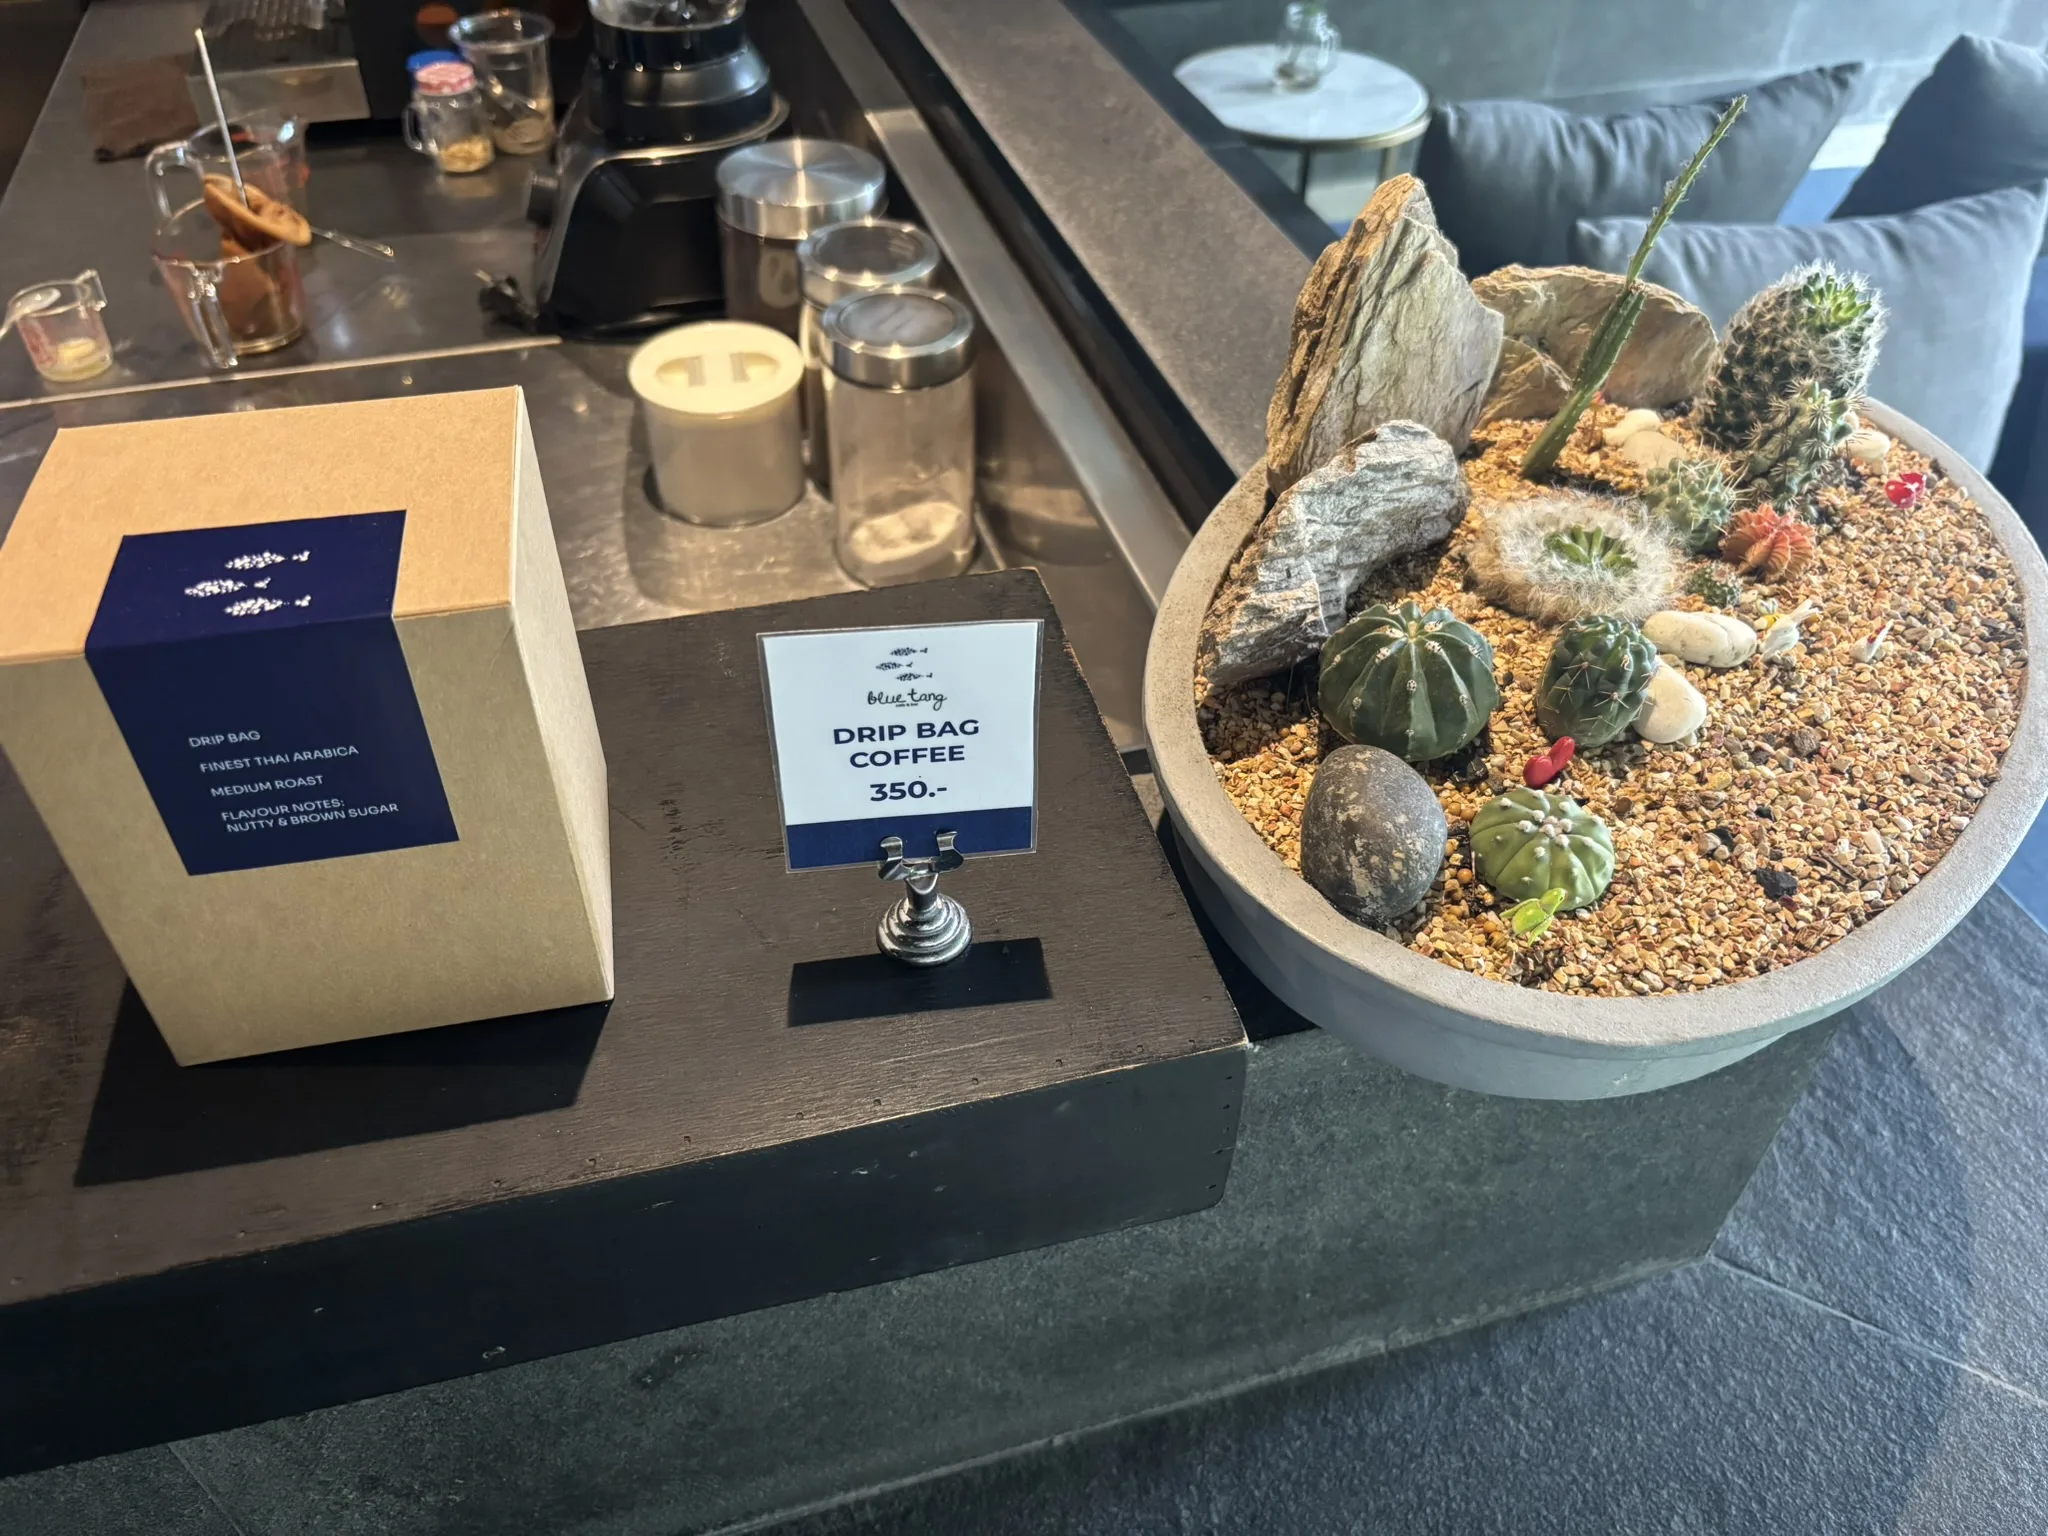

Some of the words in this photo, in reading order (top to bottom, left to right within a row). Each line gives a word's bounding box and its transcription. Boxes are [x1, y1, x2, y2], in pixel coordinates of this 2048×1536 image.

[867, 691, 907, 705] blue
[907, 688, 948, 711] tang
[188, 735, 225, 748] DRIP
[228, 730, 261, 743] BAG
[833, 724, 906, 745] DRIP
[917, 719, 980, 739] BAG
[200, 758, 252, 773] FINEST
[254, 754, 291, 768] THAI
[293, 745, 360, 763] ARABICA
[850, 745, 965, 769] COFFEE
[211, 780, 272, 797] MEDIUM
[275, 775, 324, 790] ROAST
[870, 780, 948, 802] 350.-
[221, 805, 290, 822] FLAVOUR
[292, 798, 345, 813] NOTES:
[227, 818, 275, 833] NUTTY
[278, 814, 288, 826] &
[290, 809, 346, 826] BROWN
[348, 803, 400, 818] SUGAR
